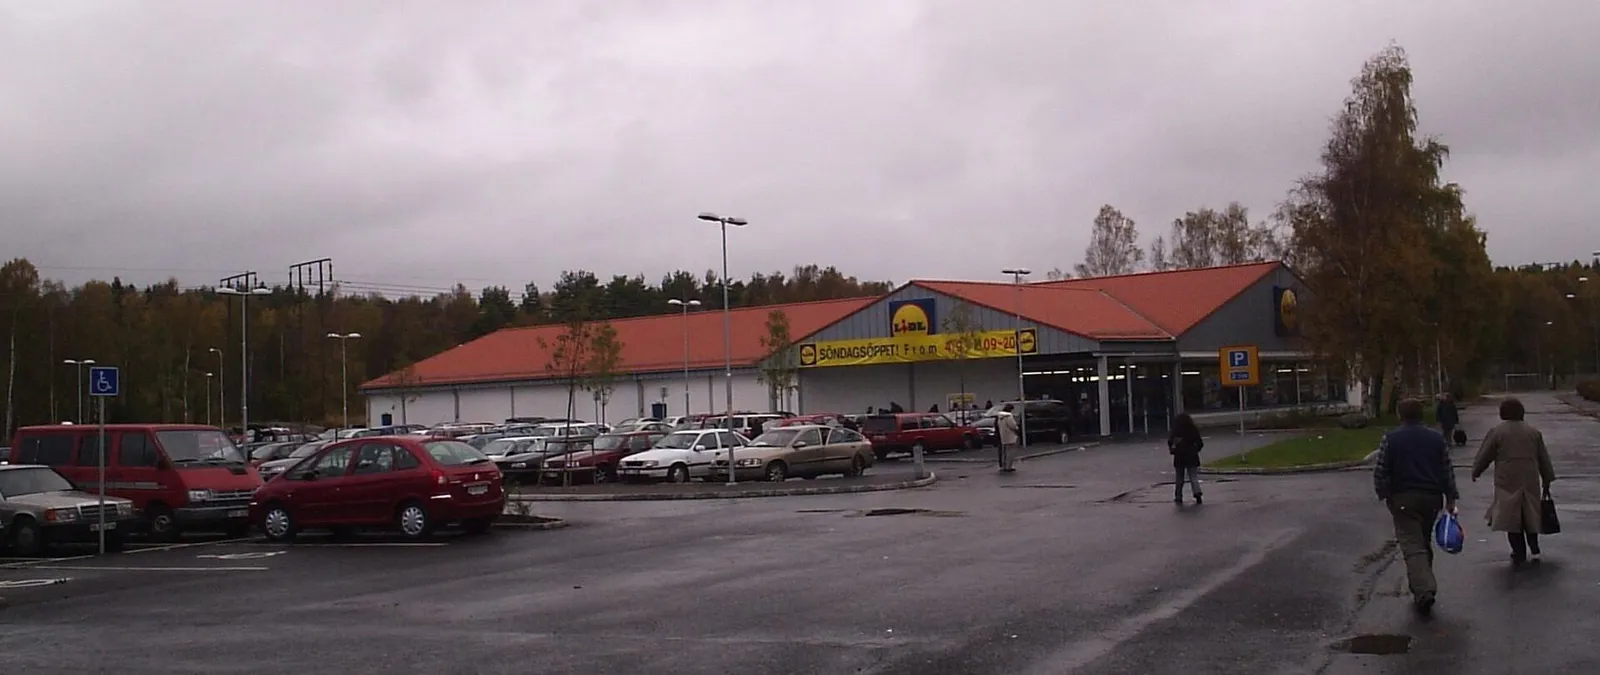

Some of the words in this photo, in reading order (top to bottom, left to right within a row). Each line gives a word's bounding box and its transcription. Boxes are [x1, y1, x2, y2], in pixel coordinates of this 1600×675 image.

[819, 342, 899, 360] SÖNDAGSÖPPET!
[983, 336, 1015, 351] 09-20
[1234, 352, 1244, 366] P
